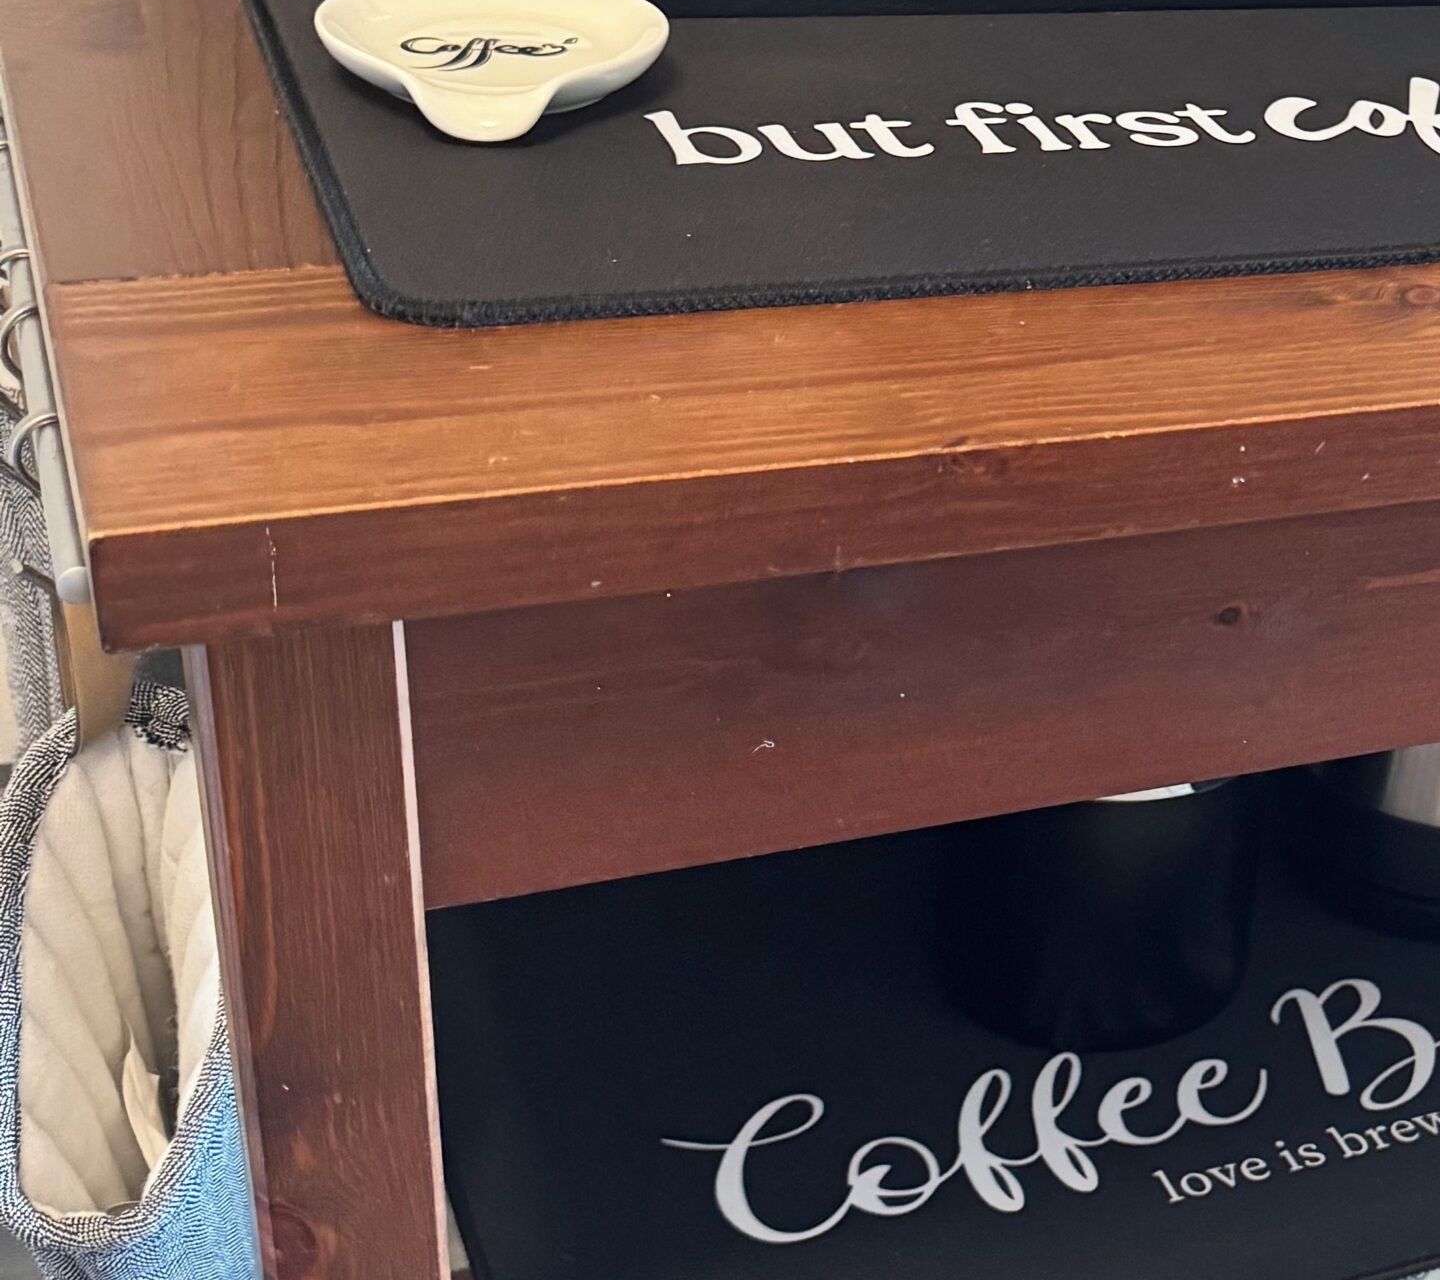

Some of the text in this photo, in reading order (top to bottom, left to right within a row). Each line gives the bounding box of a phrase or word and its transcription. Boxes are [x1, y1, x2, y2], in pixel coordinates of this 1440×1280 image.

[400, 36, 569, 71] Coffee
[644, 110, 934, 166] but
[946, 101, 1258, 155] first
[661, 1051, 1267, 1244] Coffee
[1151, 1148, 1271, 1205] love
[1277, 1135, 1327, 1176] is
